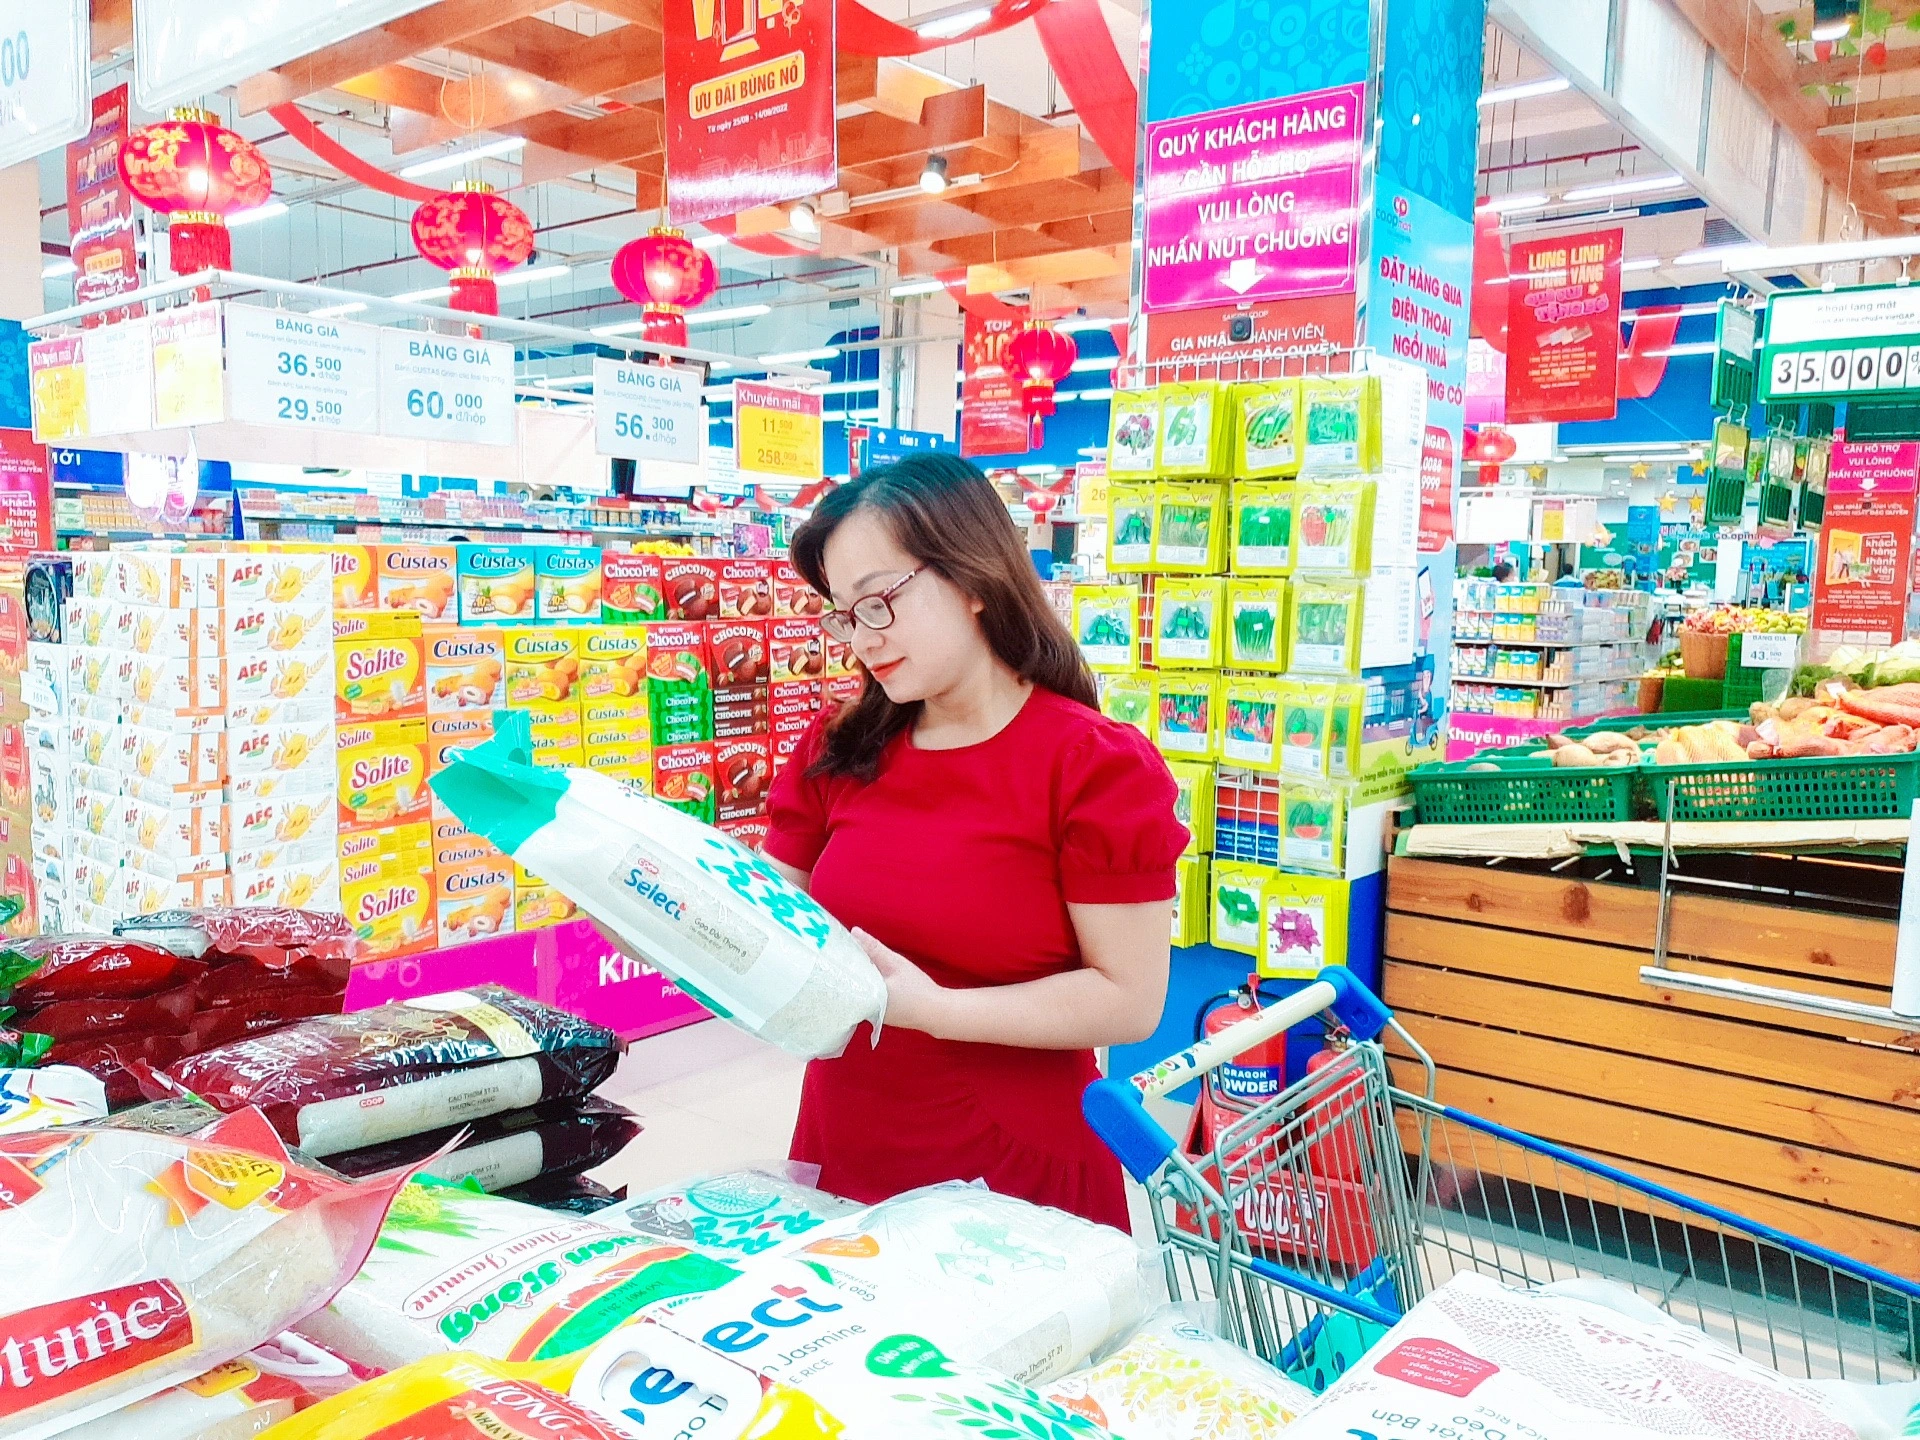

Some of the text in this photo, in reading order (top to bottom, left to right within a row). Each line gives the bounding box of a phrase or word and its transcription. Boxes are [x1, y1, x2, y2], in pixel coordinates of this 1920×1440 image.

[740, 72, 775, 99] BÙNG
[780, 56, 798, 87] NỔ
[1158, 105, 1347, 159] QUÝ KHÁCH HÀNG
[1183, 160, 1226, 188] CẦN
[1198, 191, 1296, 225] VUI LÒNG
[1148, 222, 1349, 268] NHẤN NÚT CHUÔNG
[1529, 244, 1605, 271] LUNG LINH
[1380, 255, 1463, 309] ĐẶT HÀNG QUA
[276, 318, 339, 339] BẢNG GIÁ
[984, 319, 1013, 333] TOP
[1391, 296, 1453, 341] ĐIỆN THOẠI
[1171, 322, 1325, 351] GIA VIÊN
[409, 340, 491, 366] BẢNG GIÁ
[1426, 342, 1448, 370] NHÀ
[315, 356, 341, 372] 500
[617, 369, 682, 392] BẢNG GIÁ
[455, 394, 482, 409] 000
[739, 389, 779, 407] Khuyến
[1447, 383, 1463, 406] CÓ
[316, 401, 342, 415] 500
[652, 416, 674, 431] 300
[386, 552, 449, 570] Custas
[469, 552, 526, 569] Custas
[546, 553, 595, 570] Custas
[232, 563, 263, 583] AFC
[234, 612, 265, 632] AFC
[433, 639, 496, 658] Custas
[514, 636, 569, 654] Custas
[587, 635, 638, 652] Custas
[237, 660, 268, 681] AFC
[346, 648, 407, 681] Solite
[432, 719, 478, 734] Custas
[239, 734, 270, 755] AFC
[337, 729, 372, 748] Solite
[351, 755, 412, 790] Solite
[243, 806, 273, 828] AFC
[439, 849, 484, 864] Custas
[246, 877, 275, 899] AFC
[446, 869, 506, 892] Custas
[358, 885, 417, 922] Solite
[1224, 1068, 1267, 1079] DRAGON
[783, 1322, 867, 1368] Jasmine
